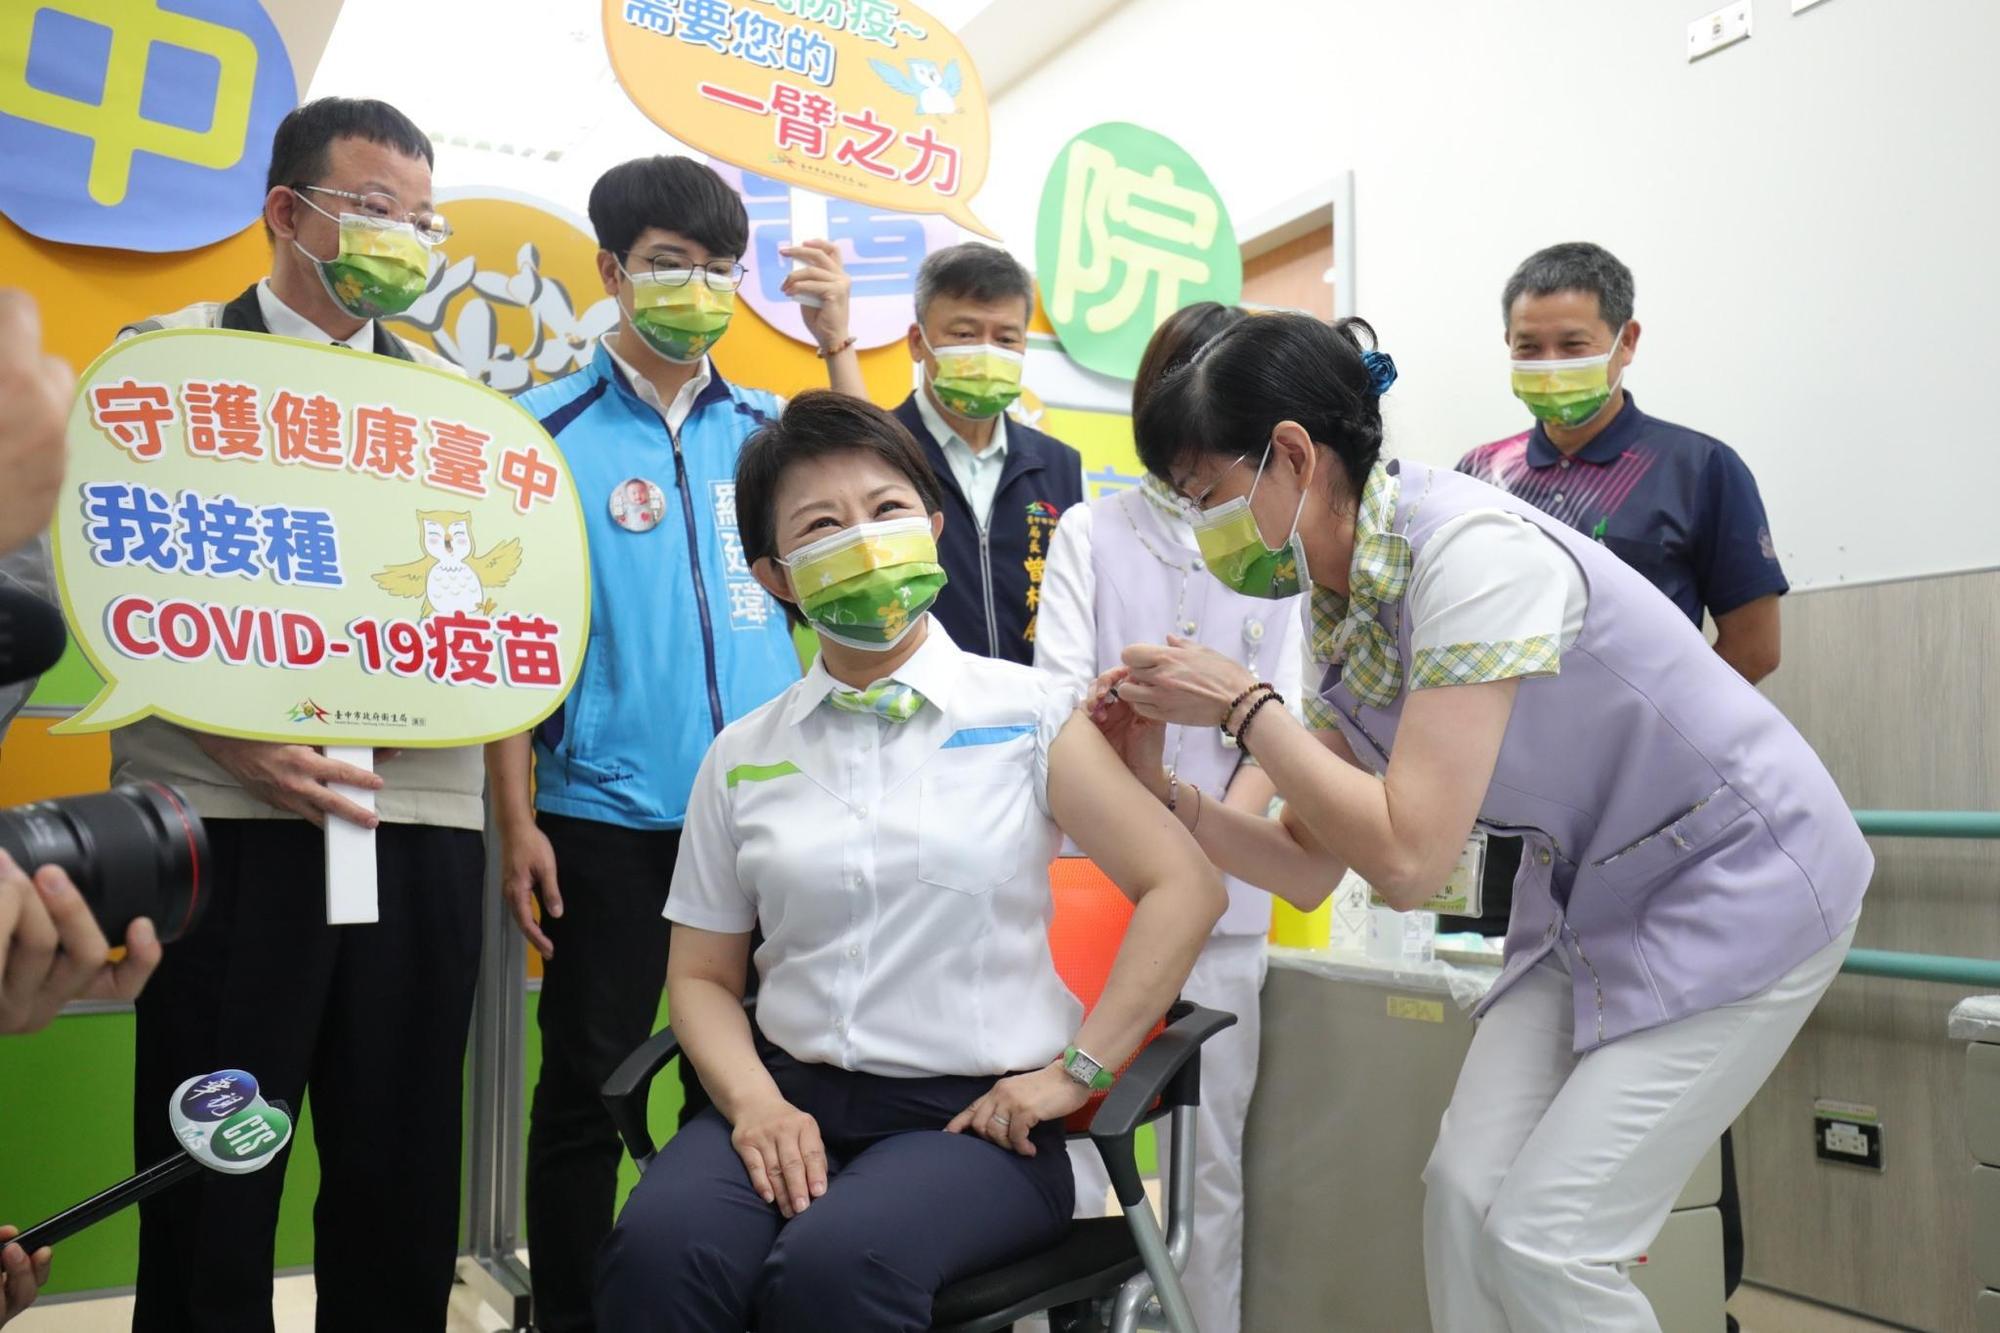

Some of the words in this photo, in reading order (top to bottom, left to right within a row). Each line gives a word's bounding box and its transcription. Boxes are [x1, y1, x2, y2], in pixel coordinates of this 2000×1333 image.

[626, 0, 835, 82] 需要您的
[775, 0, 923, 46] 防疫~
[0, 0, 259, 206] 中
[701, 84, 957, 191] 一臂之力
[1051, 139, 1219, 335] 院
[95, 380, 558, 510] 守護健康臺中
[87, 484, 344, 586] 我接種
[111, 597, 563, 687] COVID-19疫苗
[222, 1114, 277, 1156] CTS
